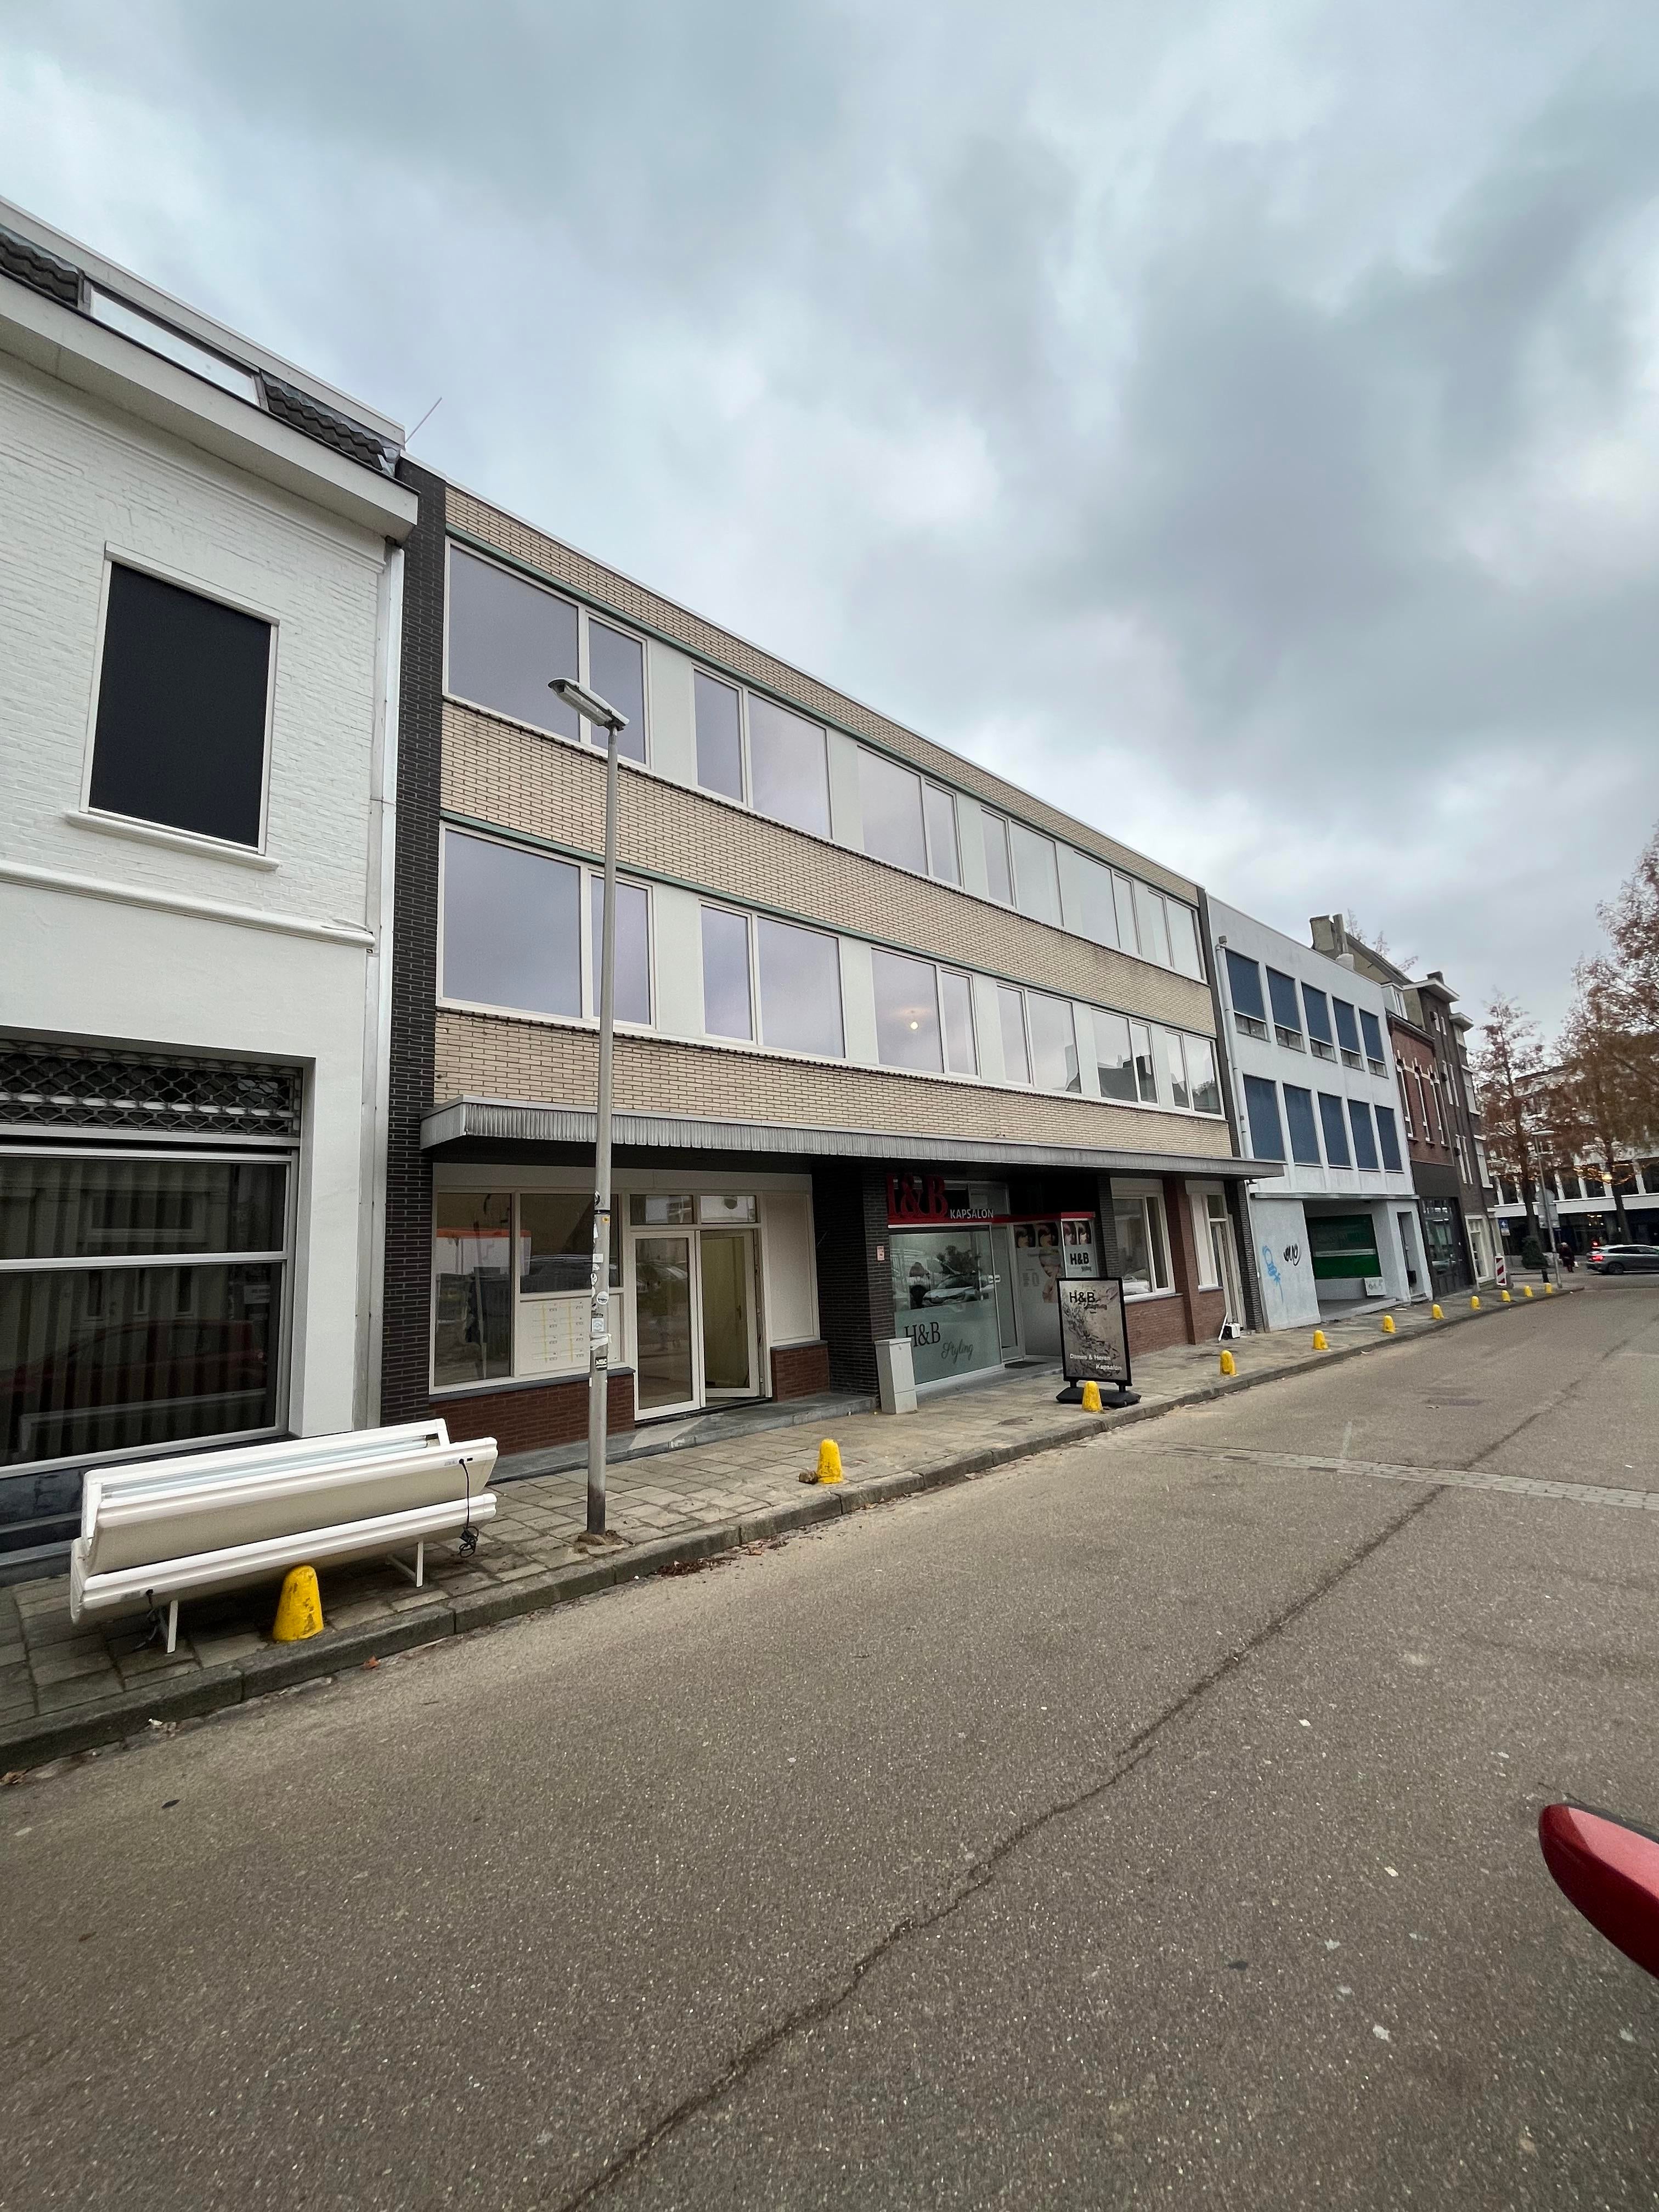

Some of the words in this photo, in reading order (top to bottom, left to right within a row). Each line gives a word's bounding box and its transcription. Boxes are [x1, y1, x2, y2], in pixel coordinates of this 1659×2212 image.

[950, 1209, 994, 1219] KAPSALON
[1070, 1252, 1089, 1265] H&B
[1069, 1292, 1096, 1303] H&B
[904, 1322, 941, 1347] H&B
